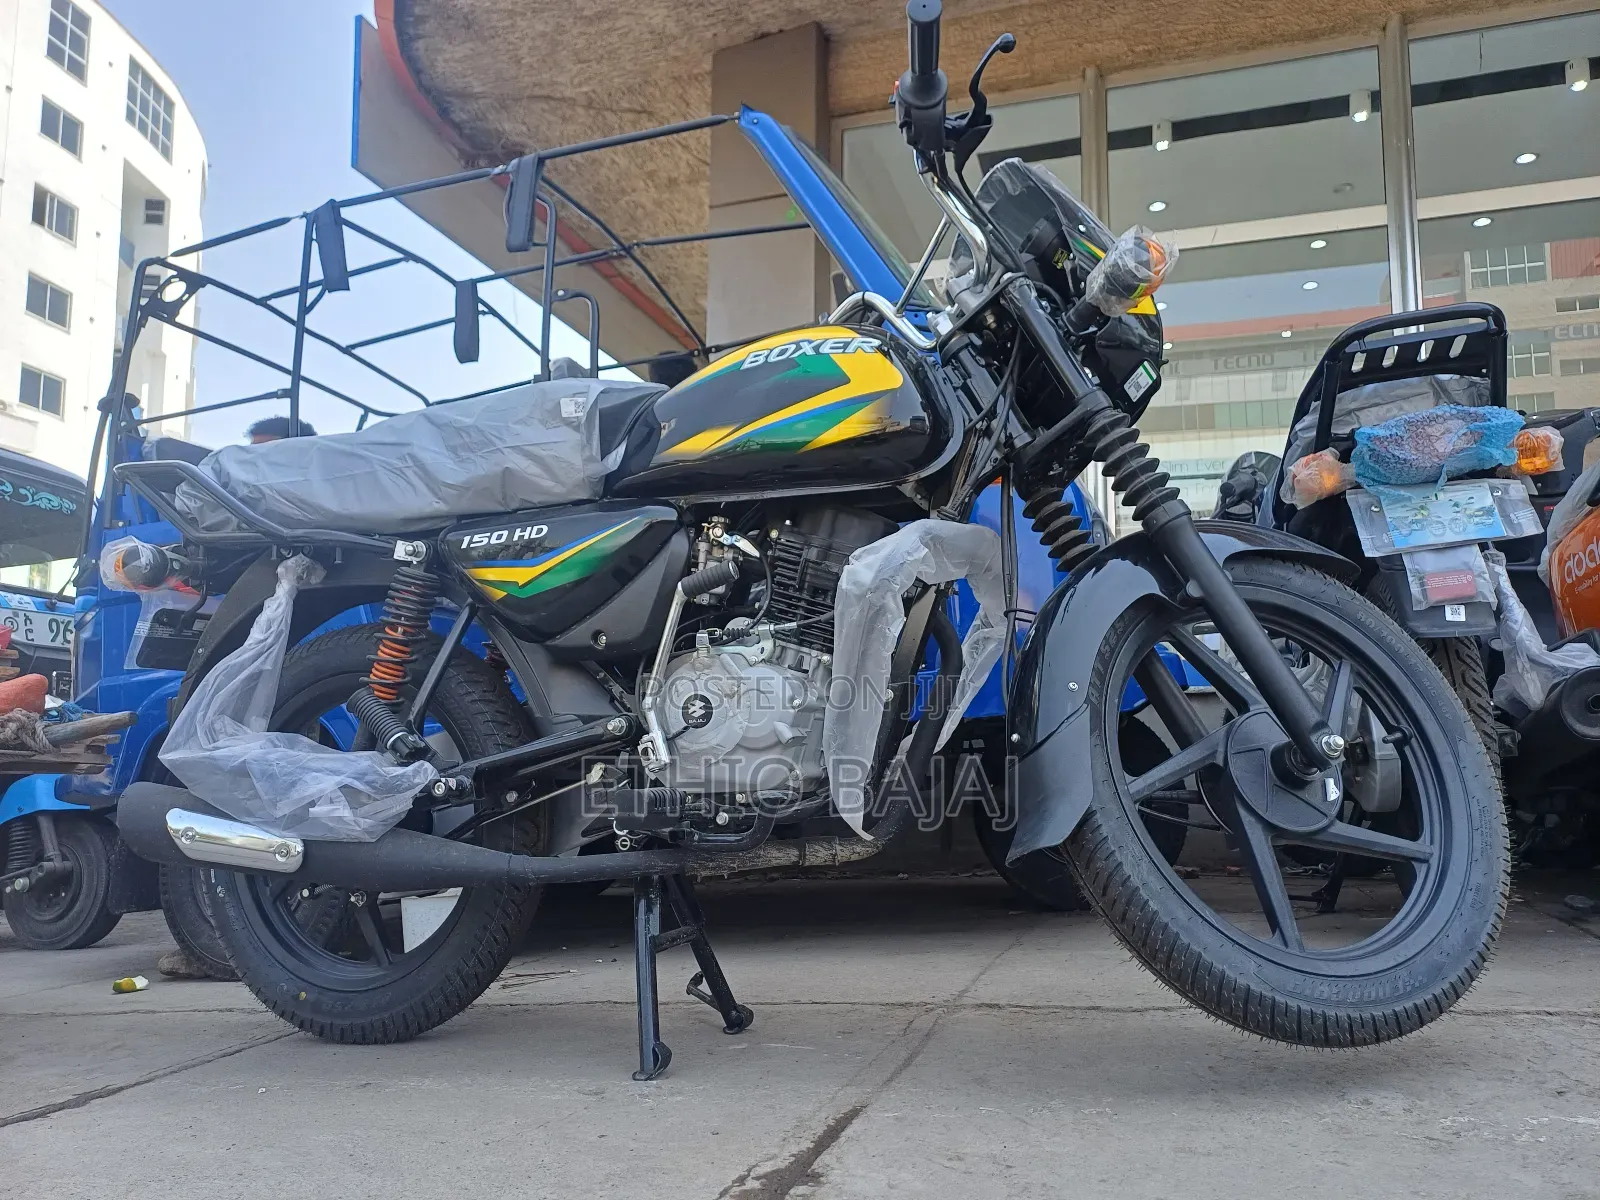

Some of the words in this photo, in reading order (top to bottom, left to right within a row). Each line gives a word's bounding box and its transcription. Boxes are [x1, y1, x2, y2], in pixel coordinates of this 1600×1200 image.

[740, 337, 882, 370] BOXER
[461, 530, 509, 549] 150
[513, 525, 549, 541] HD
[1565, 536, 1600, 583] dod
